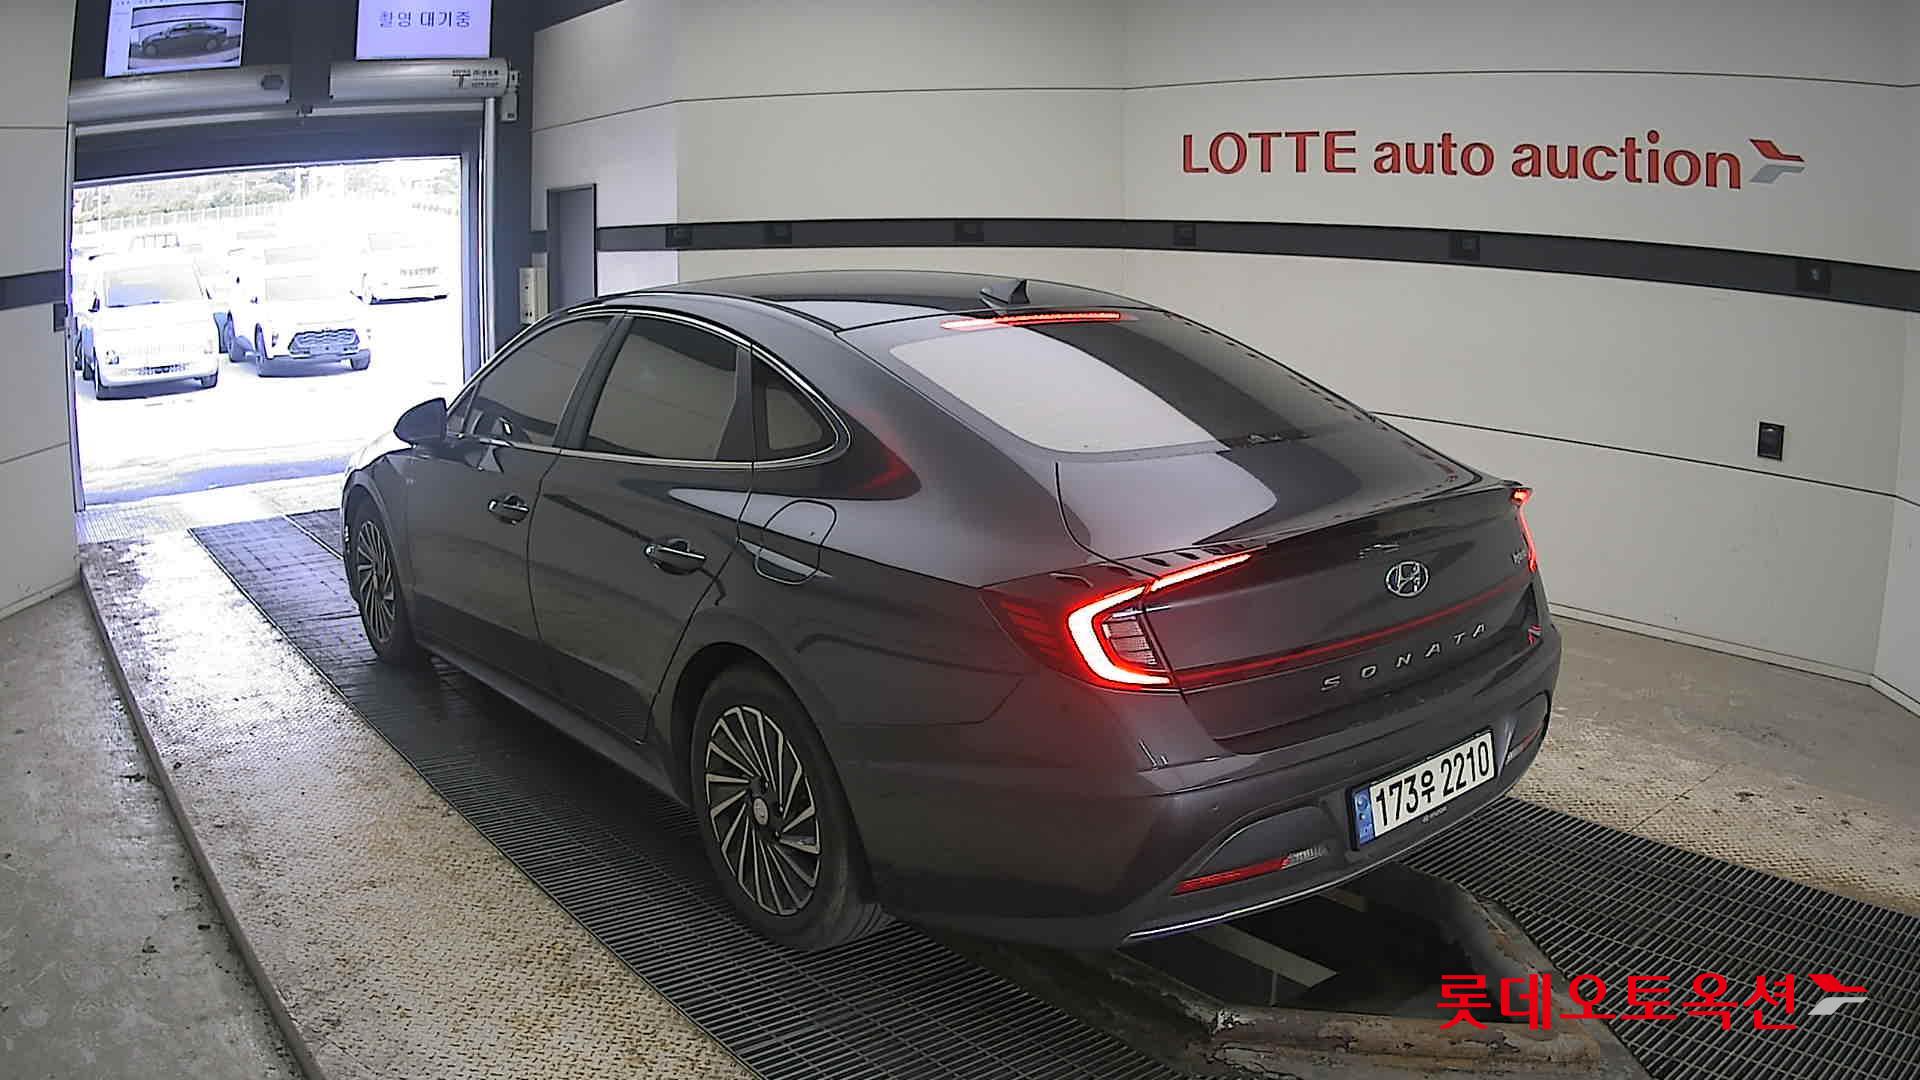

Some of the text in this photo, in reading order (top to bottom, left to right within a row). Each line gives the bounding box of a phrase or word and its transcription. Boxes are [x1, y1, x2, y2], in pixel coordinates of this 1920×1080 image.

[420, 11, 471, 28] 대기중
[1183, 129, 1742, 190] LOTTE auto auction
[1320, 623, 1486, 692] SONATA
[1375, 740, 1490, 827] 173우 2210
